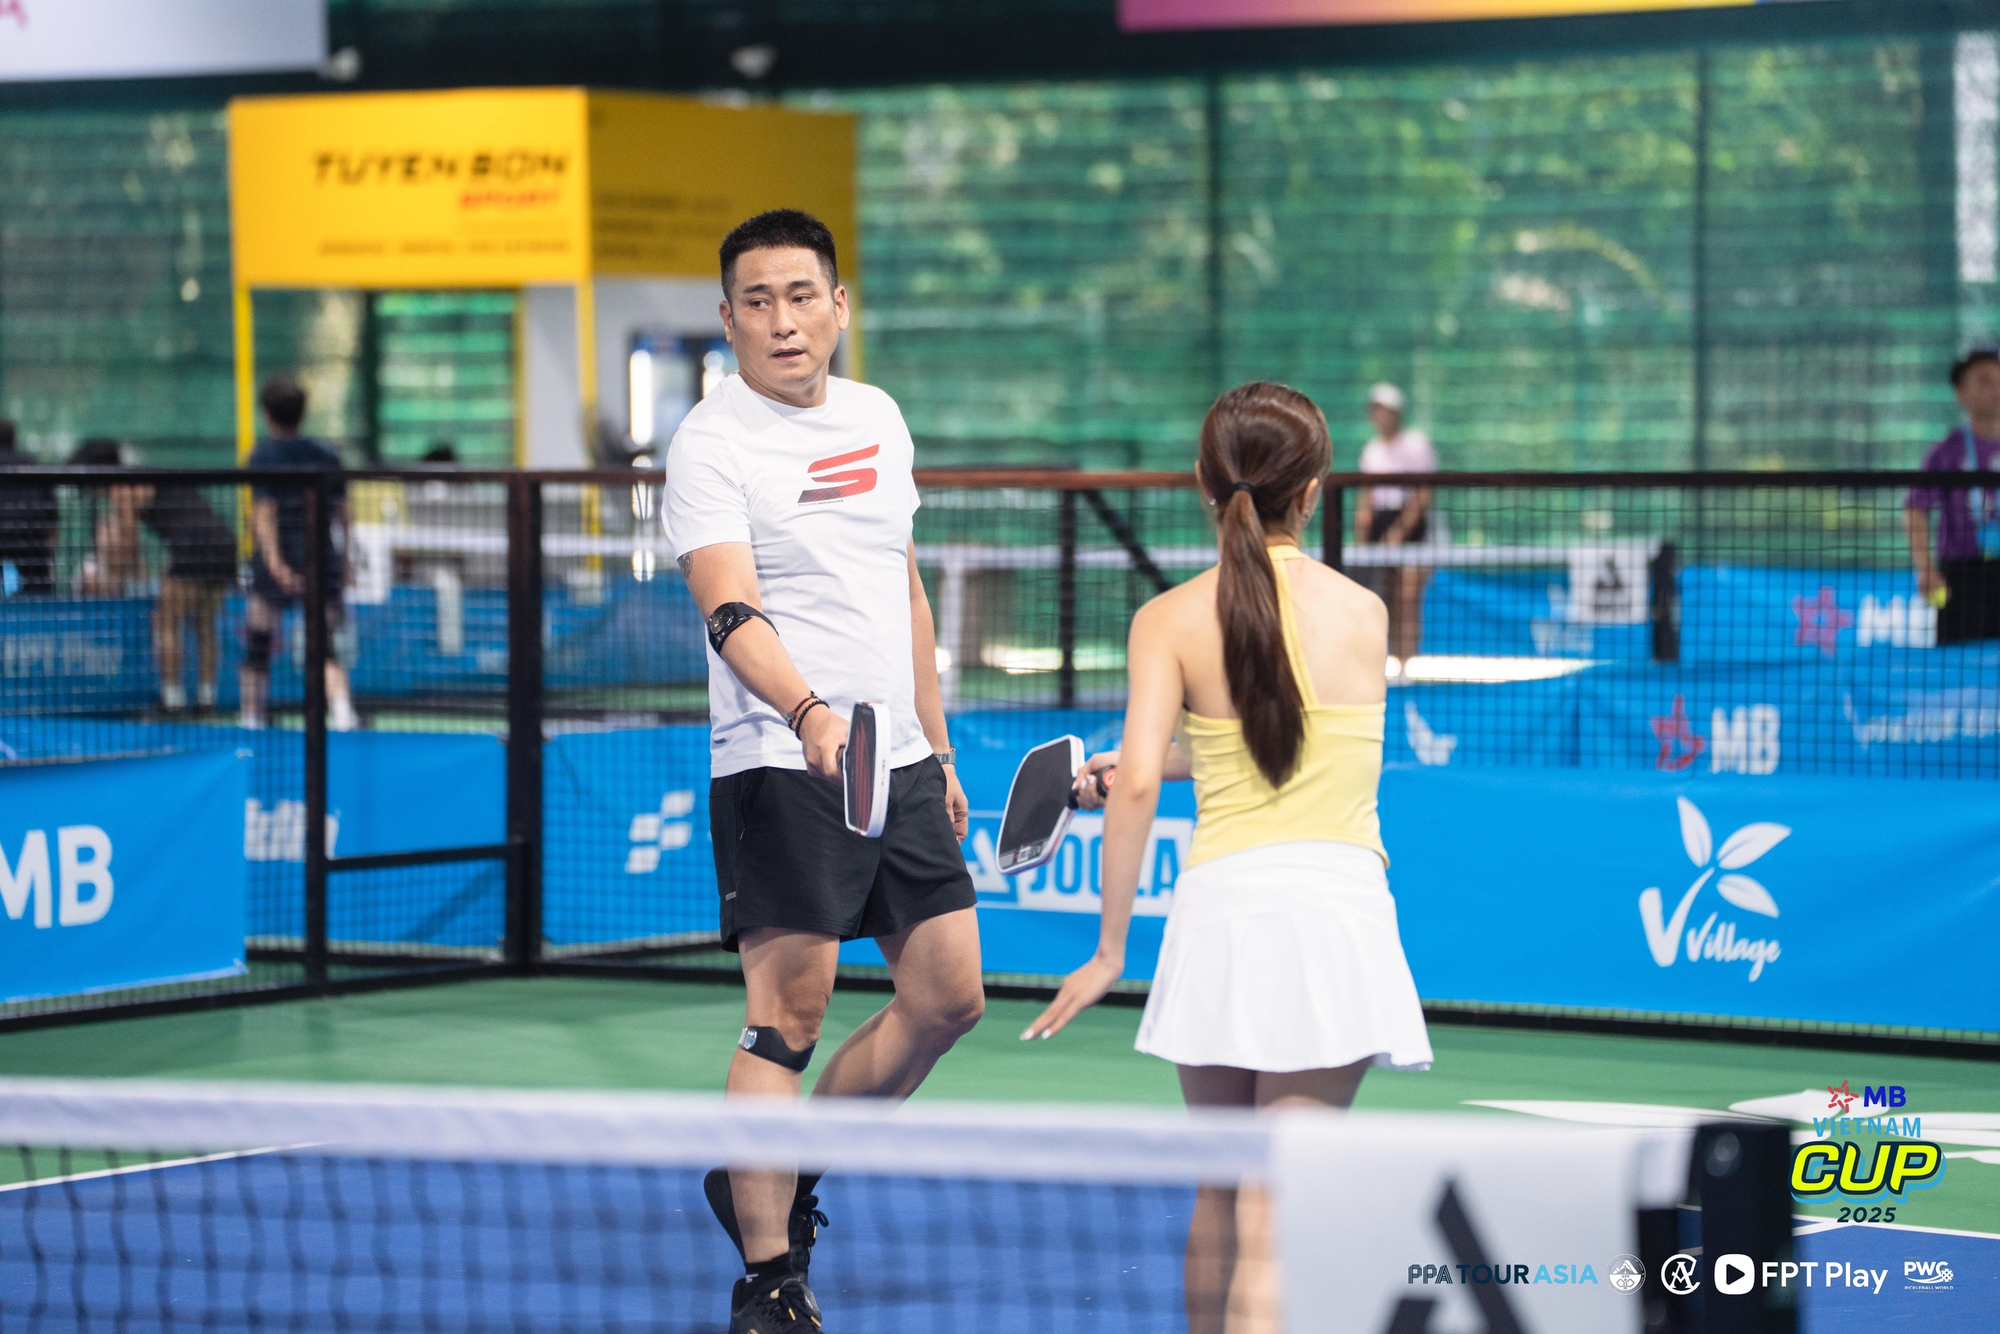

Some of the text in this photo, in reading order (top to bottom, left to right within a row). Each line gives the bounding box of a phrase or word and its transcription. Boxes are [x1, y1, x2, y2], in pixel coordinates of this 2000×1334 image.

[1711, 703, 1781, 775] MB
[0, 824, 114, 929] MB
[1686, 911, 1782, 983] Village
